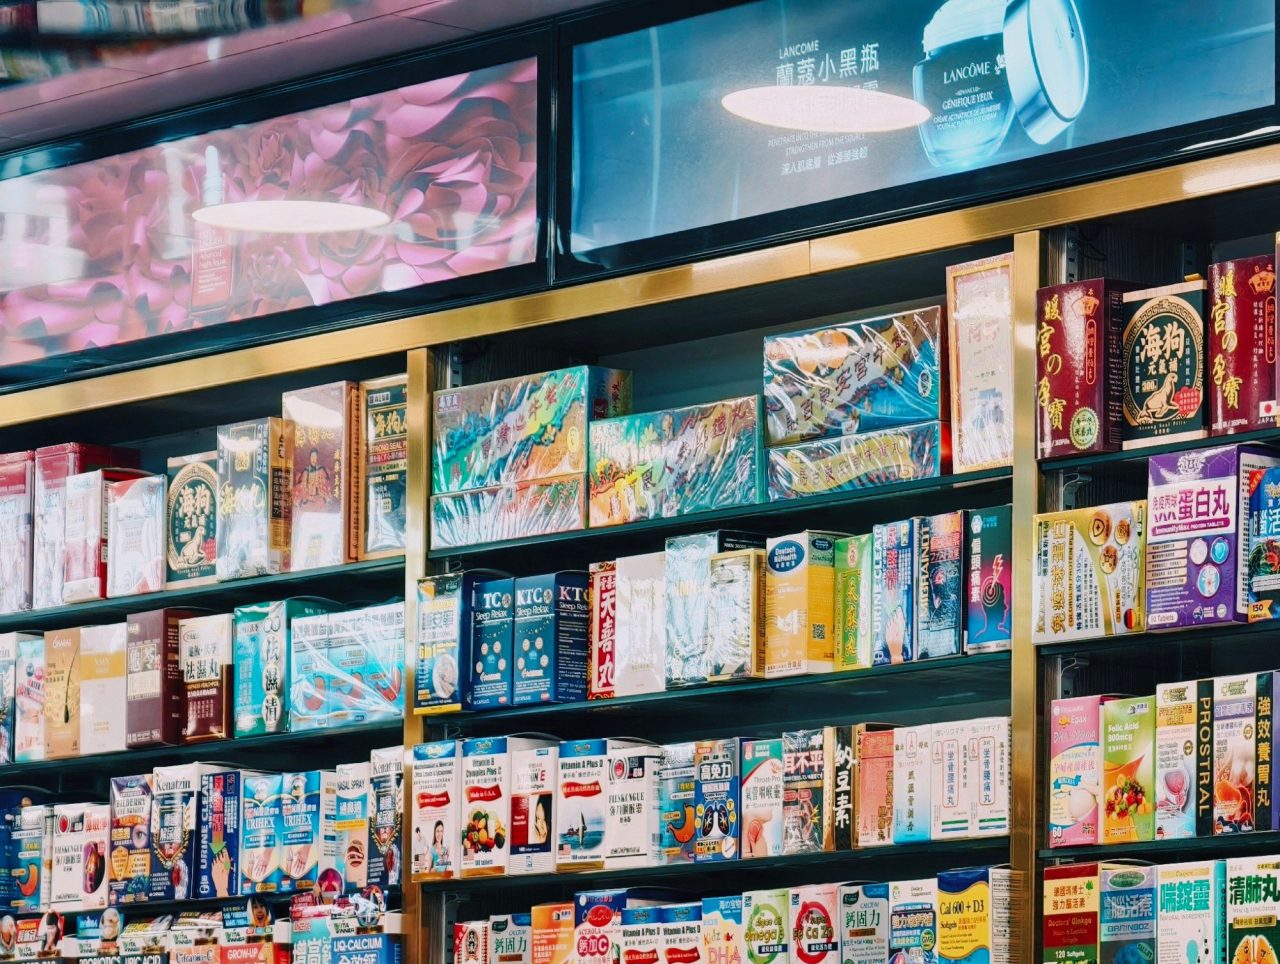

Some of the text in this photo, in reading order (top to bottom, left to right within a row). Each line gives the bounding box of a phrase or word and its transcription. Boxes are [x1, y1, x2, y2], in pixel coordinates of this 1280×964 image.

[779, 40, 819, 60] LANCOME
[943, 62, 990, 84] LANCÔME
[516, 588, 542, 605] KTC
[517, 607, 531, 616] Sleep
[1123, 721, 1139, 730] Acid
[1199, 697, 1211, 817] PROSTRAL
[156, 778, 191, 792] Kenatzin
[200, 775, 209, 870] URINE CLEAR
[246, 817, 275, 829] URIHEX
[284, 814, 312, 827] URIHEX
[939, 900, 984, 916] Cal 600 D3
[227, 948, 258, 961] GROW-UP
